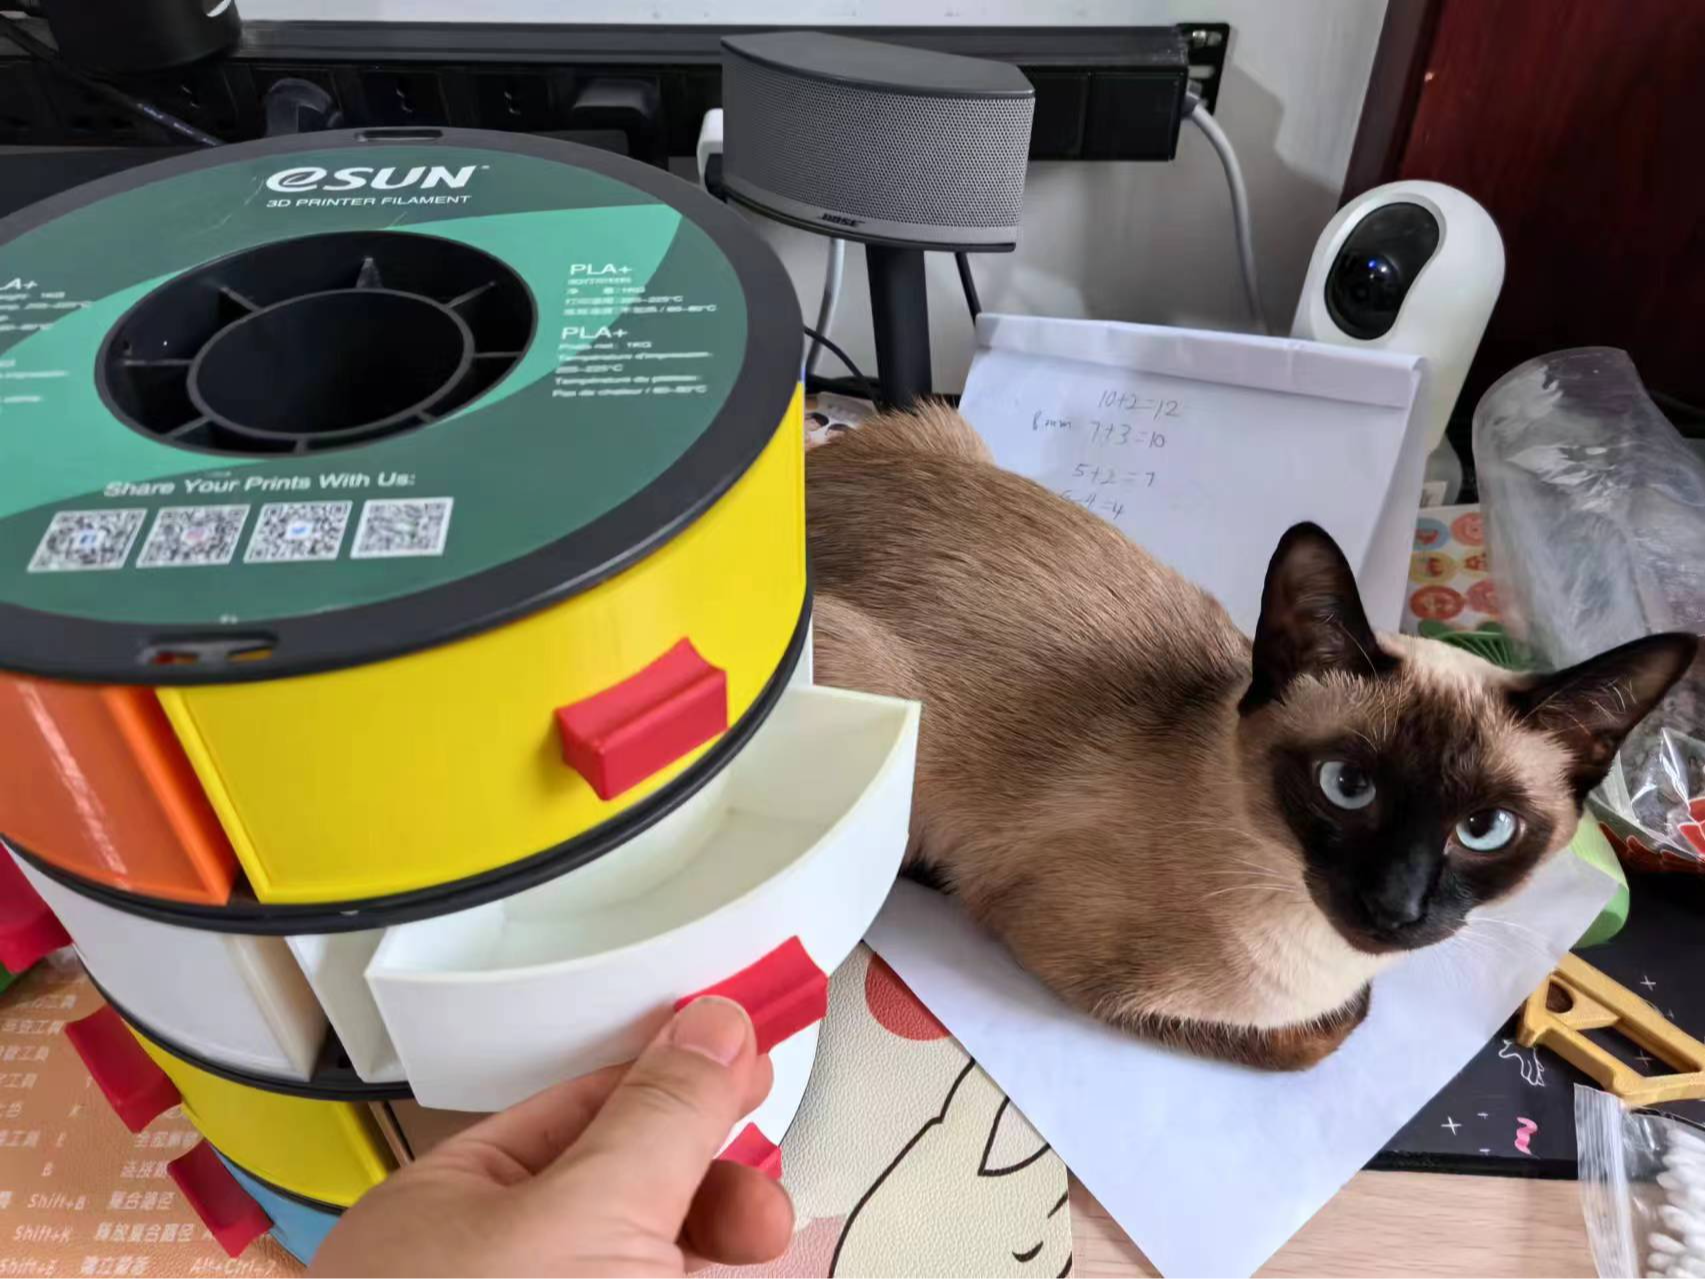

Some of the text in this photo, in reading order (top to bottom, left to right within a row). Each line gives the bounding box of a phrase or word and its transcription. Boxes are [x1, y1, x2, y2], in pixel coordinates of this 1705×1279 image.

[266, 195, 472, 208] 3D PRINTER FILAMENT
[570, 263, 633, 275] PLA+
[561, 326, 628, 340] PLA+
[104, 471, 416, 497] Share Your Prints With Us:
